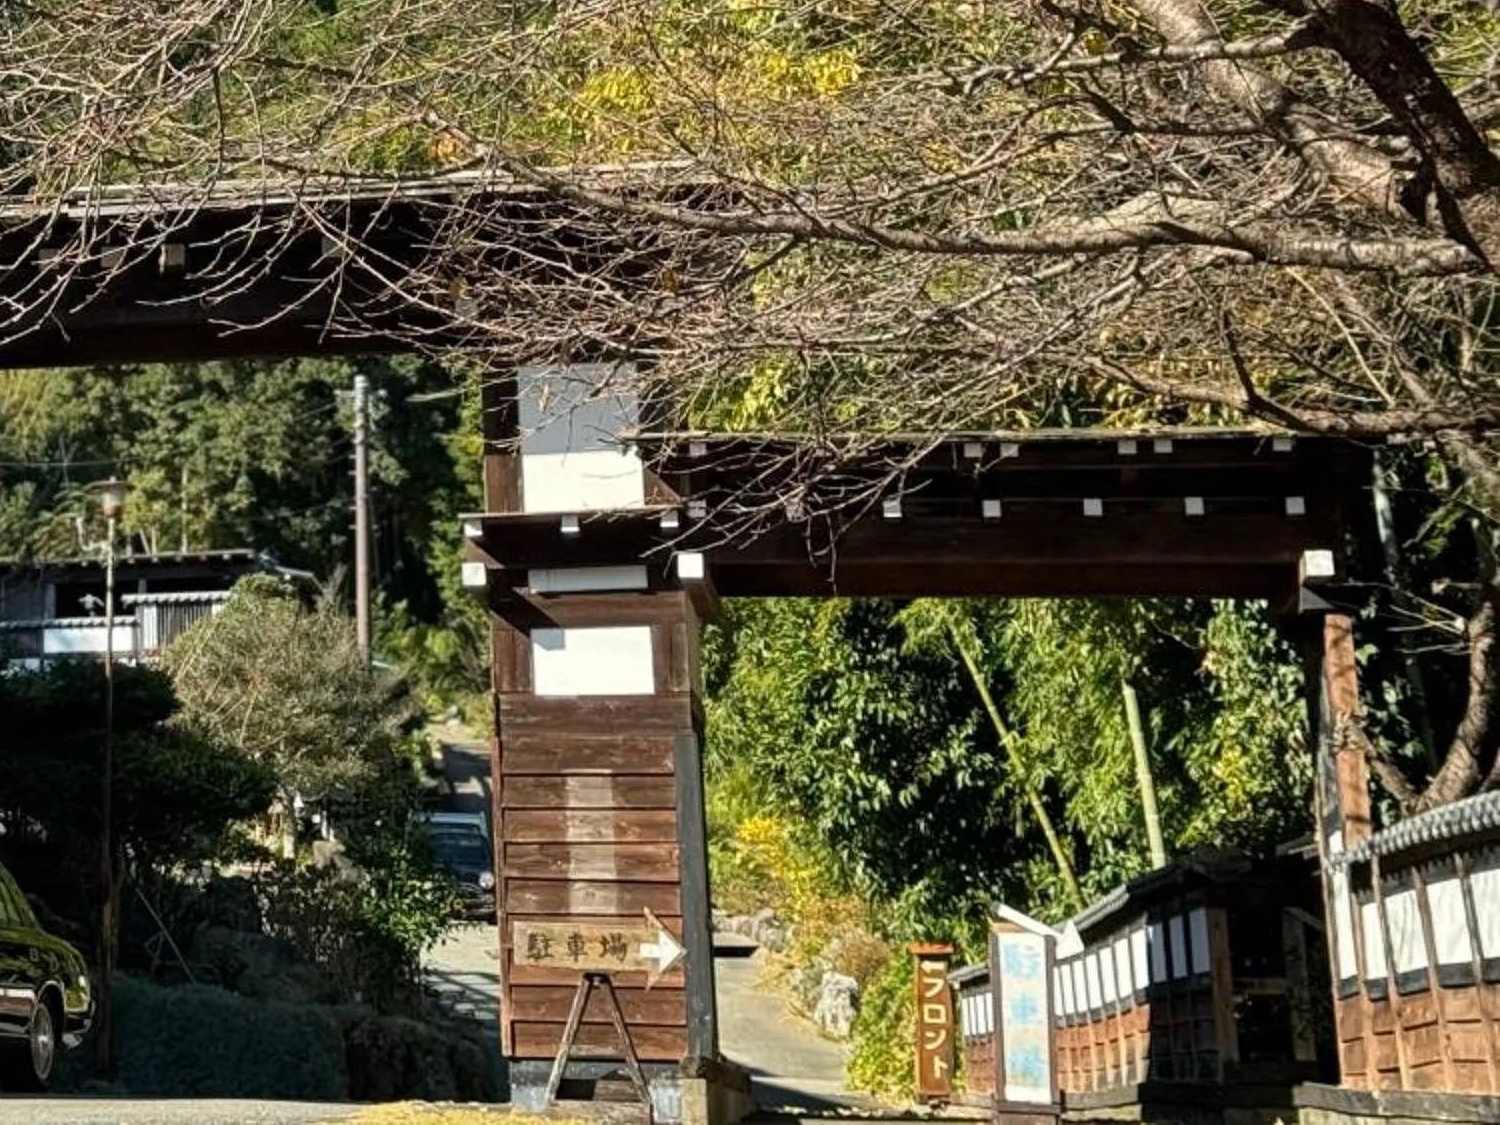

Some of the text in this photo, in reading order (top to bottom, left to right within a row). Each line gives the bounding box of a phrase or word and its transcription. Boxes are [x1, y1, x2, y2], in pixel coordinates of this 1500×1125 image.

[526, 932, 629, 964] 駐車場
[922, 978, 949, 1080] フロント
